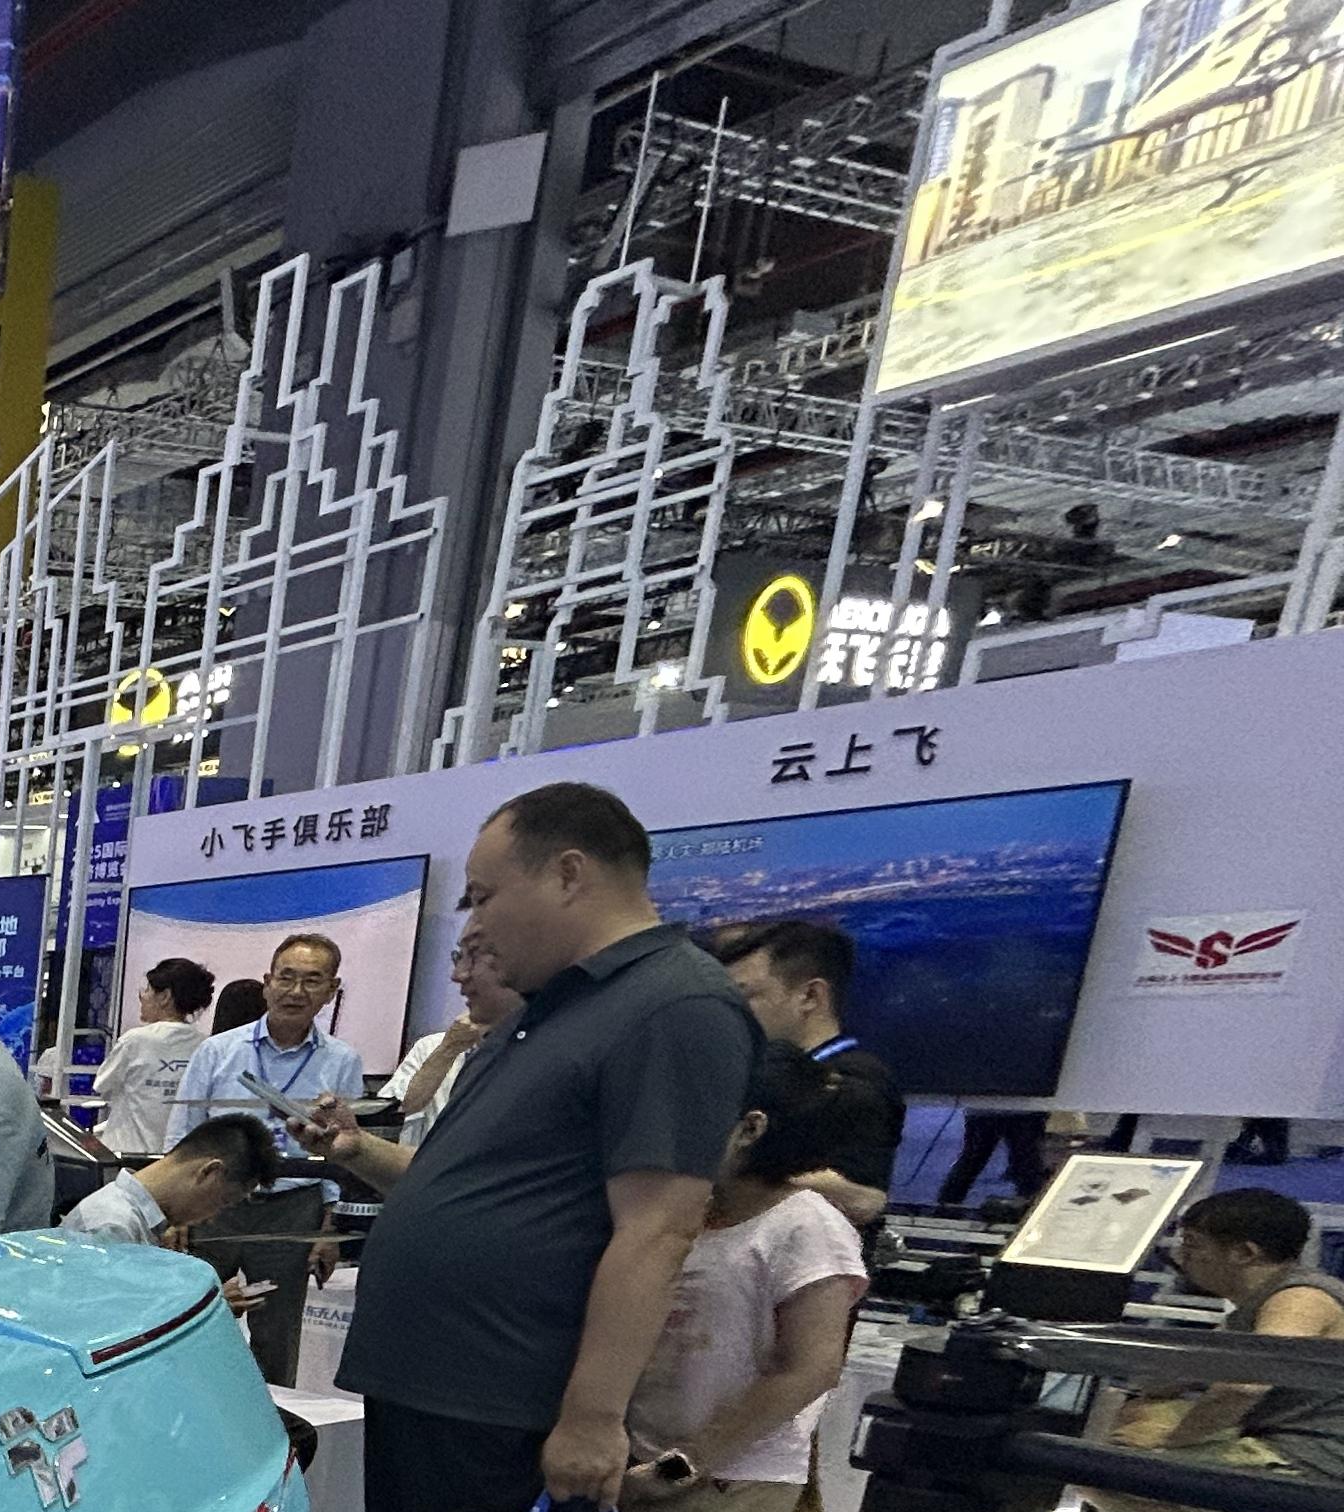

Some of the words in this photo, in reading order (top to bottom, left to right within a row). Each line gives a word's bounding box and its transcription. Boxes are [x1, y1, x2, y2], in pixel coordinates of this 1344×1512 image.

[770, 724, 942, 784] 云上飞
[200, 803, 392, 858] 小飞手俱乐部
